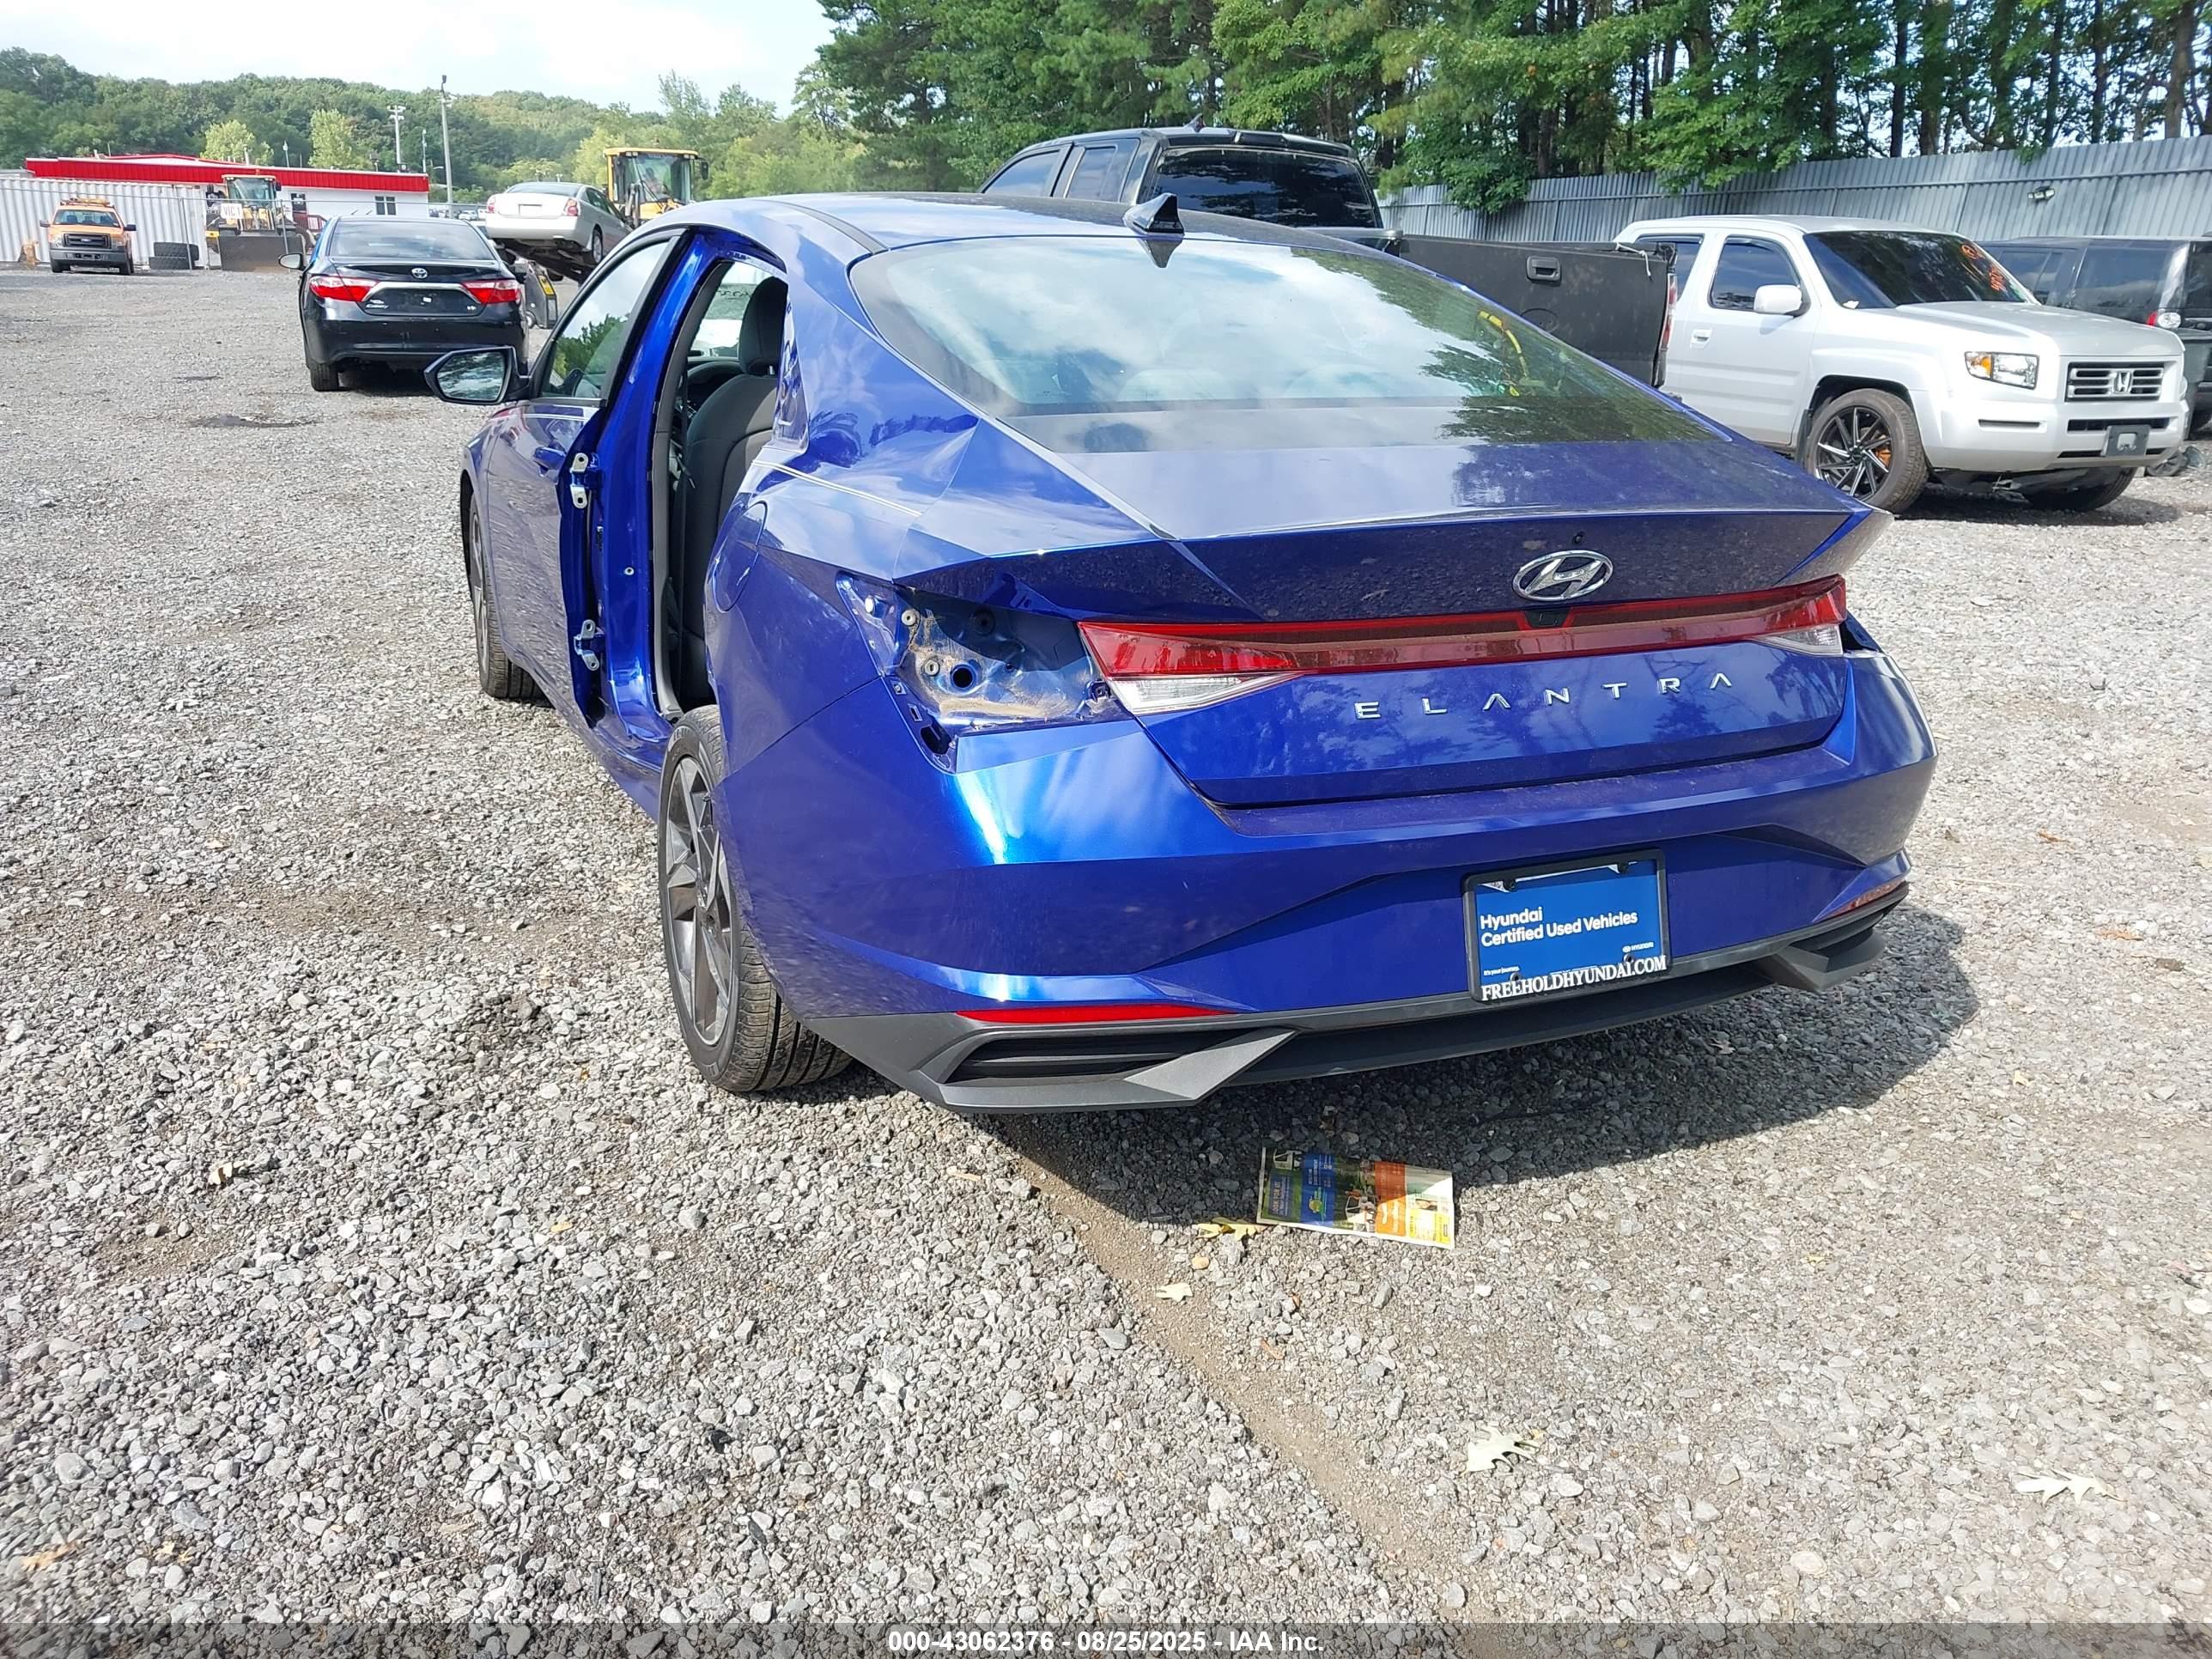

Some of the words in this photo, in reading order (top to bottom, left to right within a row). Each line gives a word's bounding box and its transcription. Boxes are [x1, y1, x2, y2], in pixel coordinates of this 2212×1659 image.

[1354, 672, 1732, 720] ELANTRA
[1480, 907, 1543, 931] Hyundai
[1480, 924, 1544, 947] Certified
[1546, 918, 1582, 938] Used
[1583, 912, 1638, 932] Vehicles
[1481, 954, 1668, 1002] FREEHOLDHYUNDAI.COM
